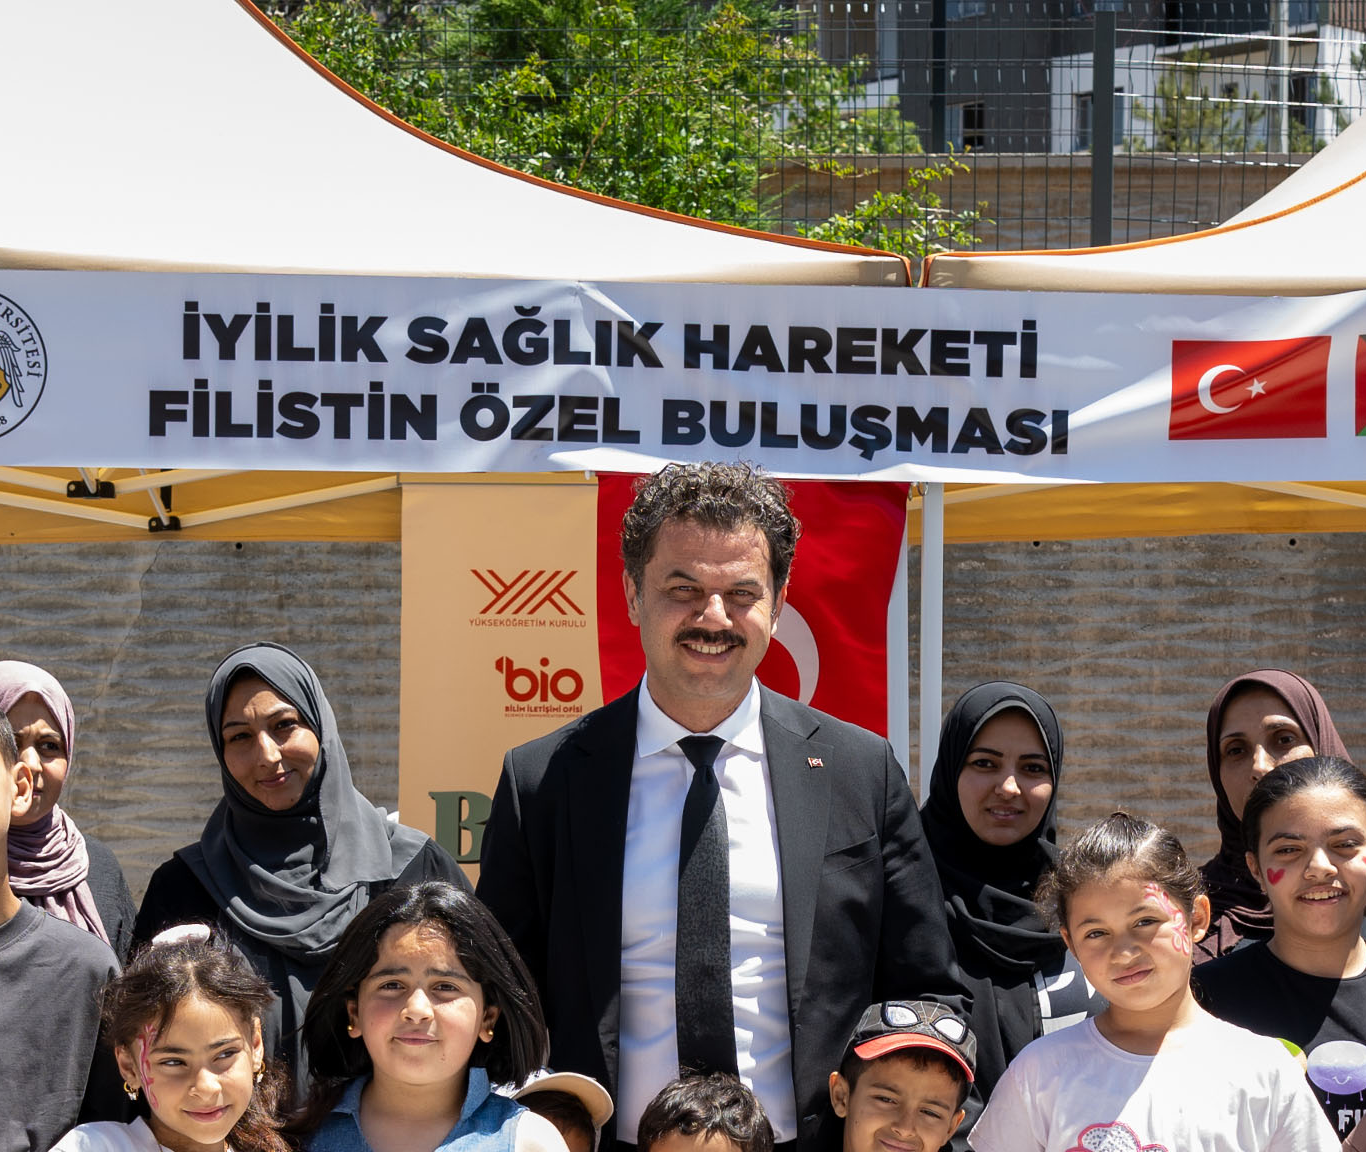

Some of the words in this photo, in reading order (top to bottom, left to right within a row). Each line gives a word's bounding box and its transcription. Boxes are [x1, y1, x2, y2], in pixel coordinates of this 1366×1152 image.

[182, 301, 388, 363] İYİLİK
[405, 305, 664, 368] SAĞLIK
[684, 319, 1037, 378] HAREKETİ
[148, 378, 437, 441] FİLİSTİN
[459, 382, 640, 444] ÖZEL
[661, 399, 1069, 461] BULUŞMASI
[469, 618, 546, 628] YÜKSEKÖĞRETİM
[549, 619, 586, 628] KURULU
[503, 656, 584, 703] bio
